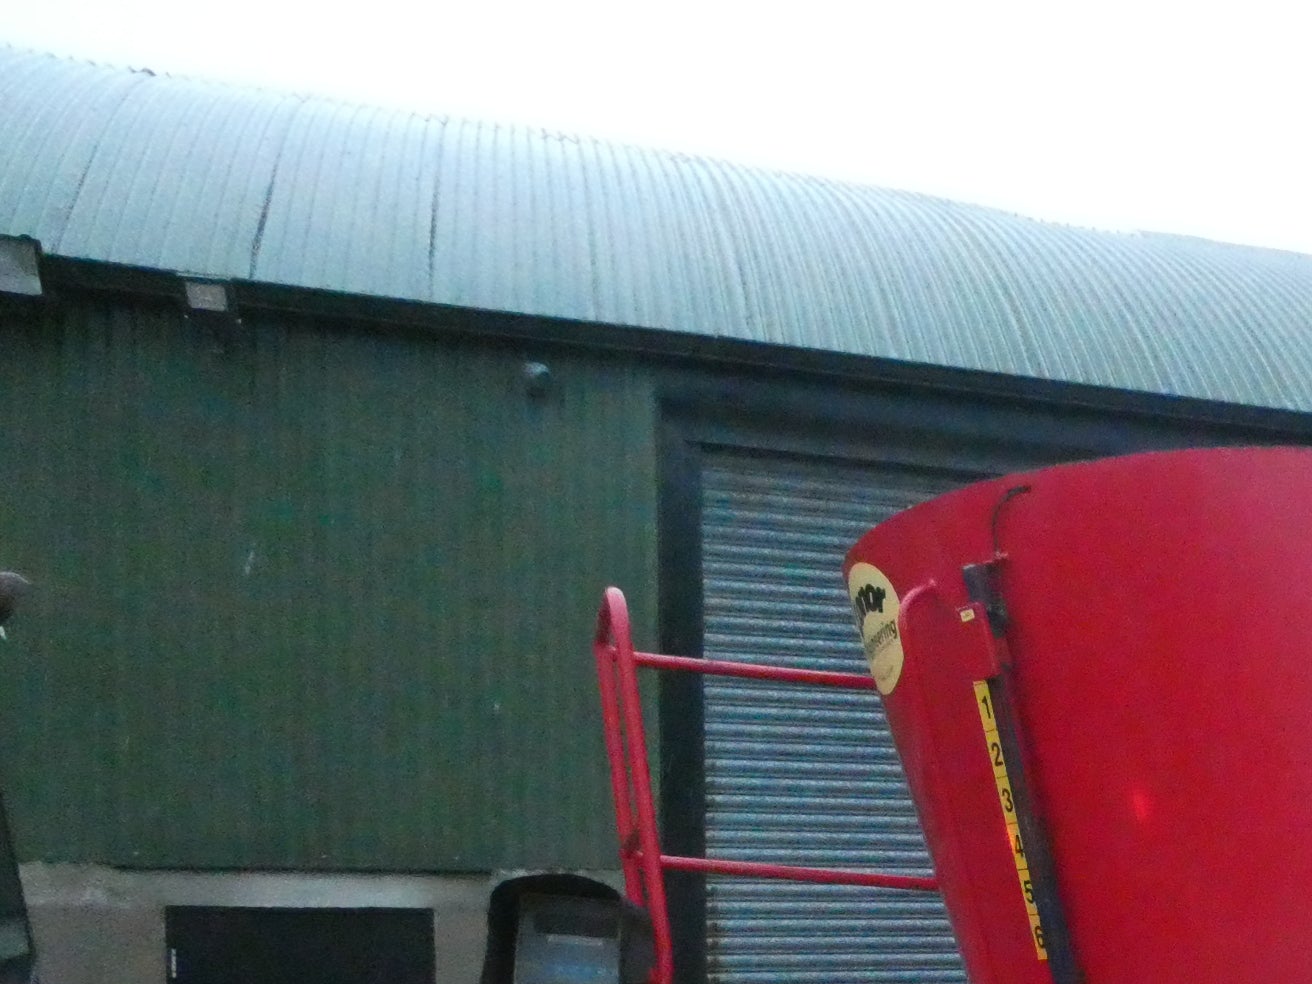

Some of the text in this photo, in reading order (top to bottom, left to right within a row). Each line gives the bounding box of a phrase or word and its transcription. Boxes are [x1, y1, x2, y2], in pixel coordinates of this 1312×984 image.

[981, 695, 991, 719] 1
[991, 742, 1004, 767] 2
[1001, 788, 1014, 813] 3
[1014, 834, 1024, 858] 4
[1023, 879, 1035, 904] 5
[1034, 925, 1045, 949] 6
